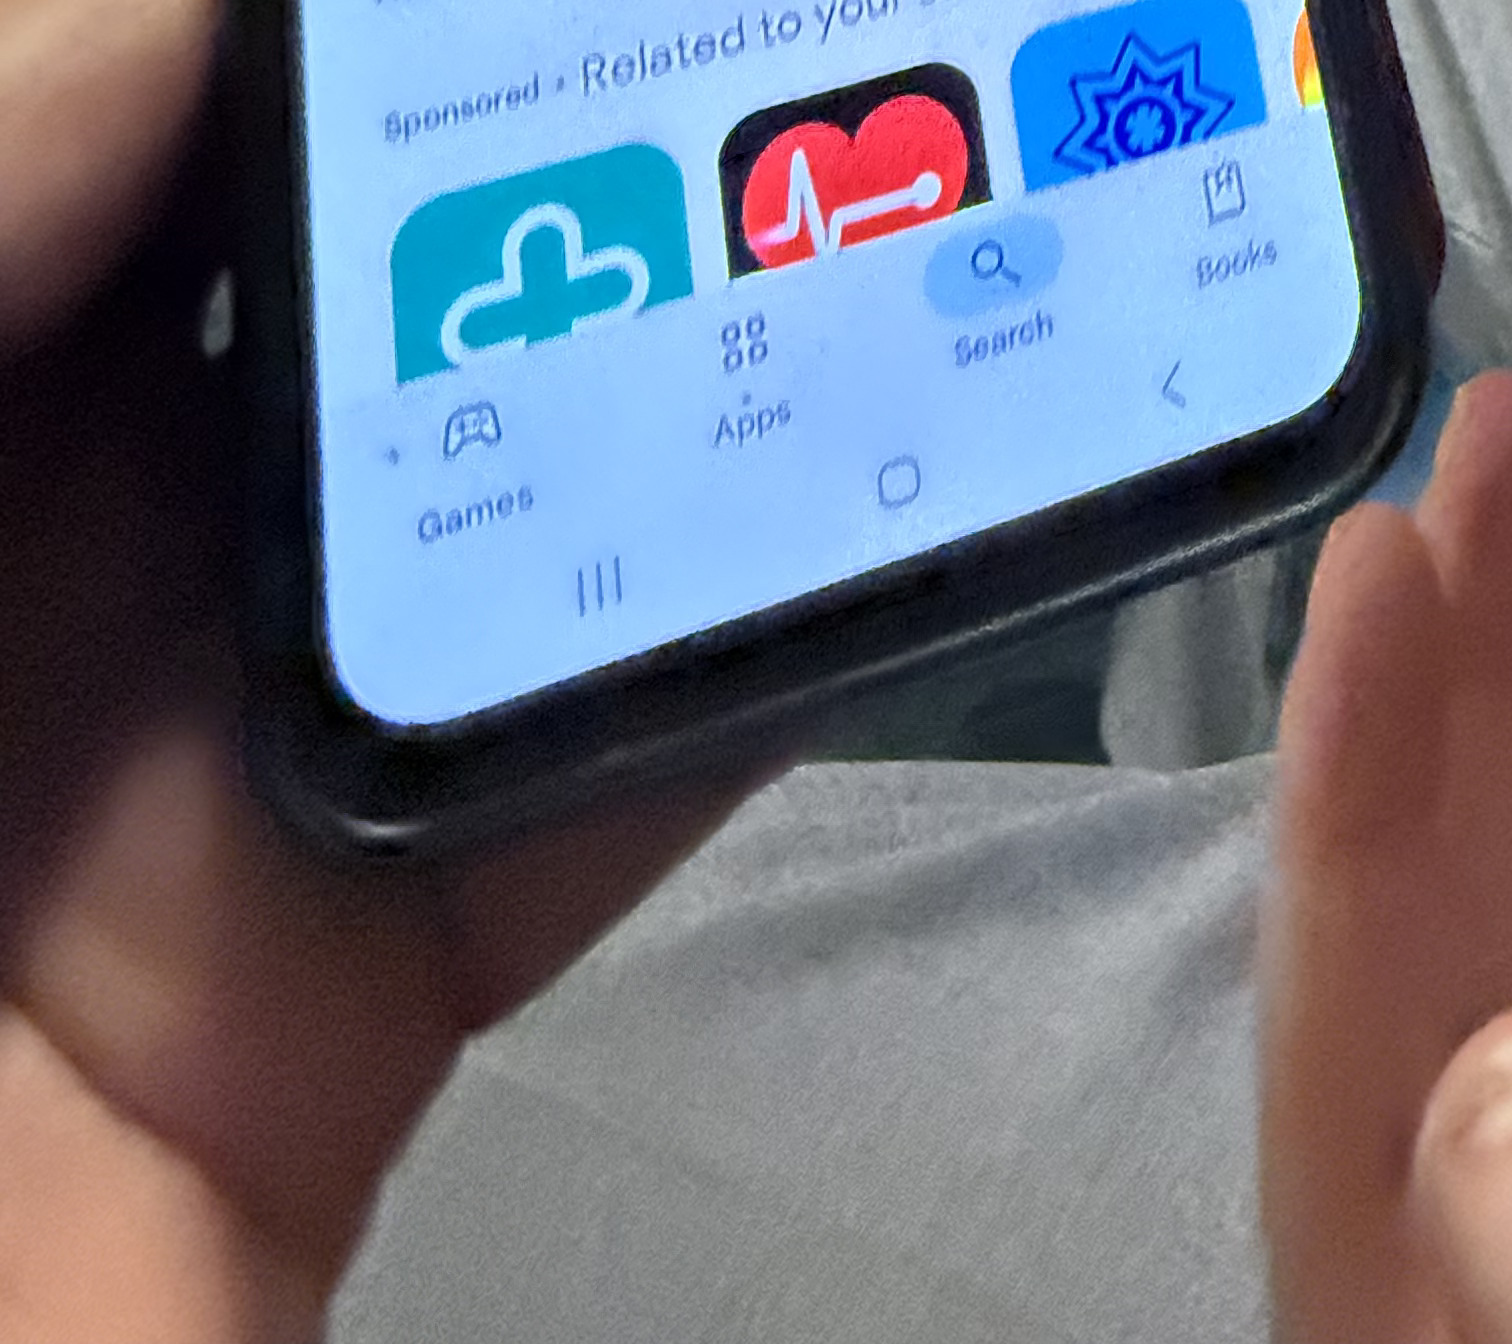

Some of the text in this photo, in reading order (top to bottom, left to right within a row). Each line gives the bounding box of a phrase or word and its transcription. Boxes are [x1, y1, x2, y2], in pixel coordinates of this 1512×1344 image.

[384, 71, 539, 144] Sponsored
[581, 16, 745, 97] Related
[758, 8, 801, 48] to
[1196, 238, 1279, 290] Books
[954, 308, 1054, 369] Search
[712, 399, 792, 448] Apps
[416, 484, 534, 545] Games
